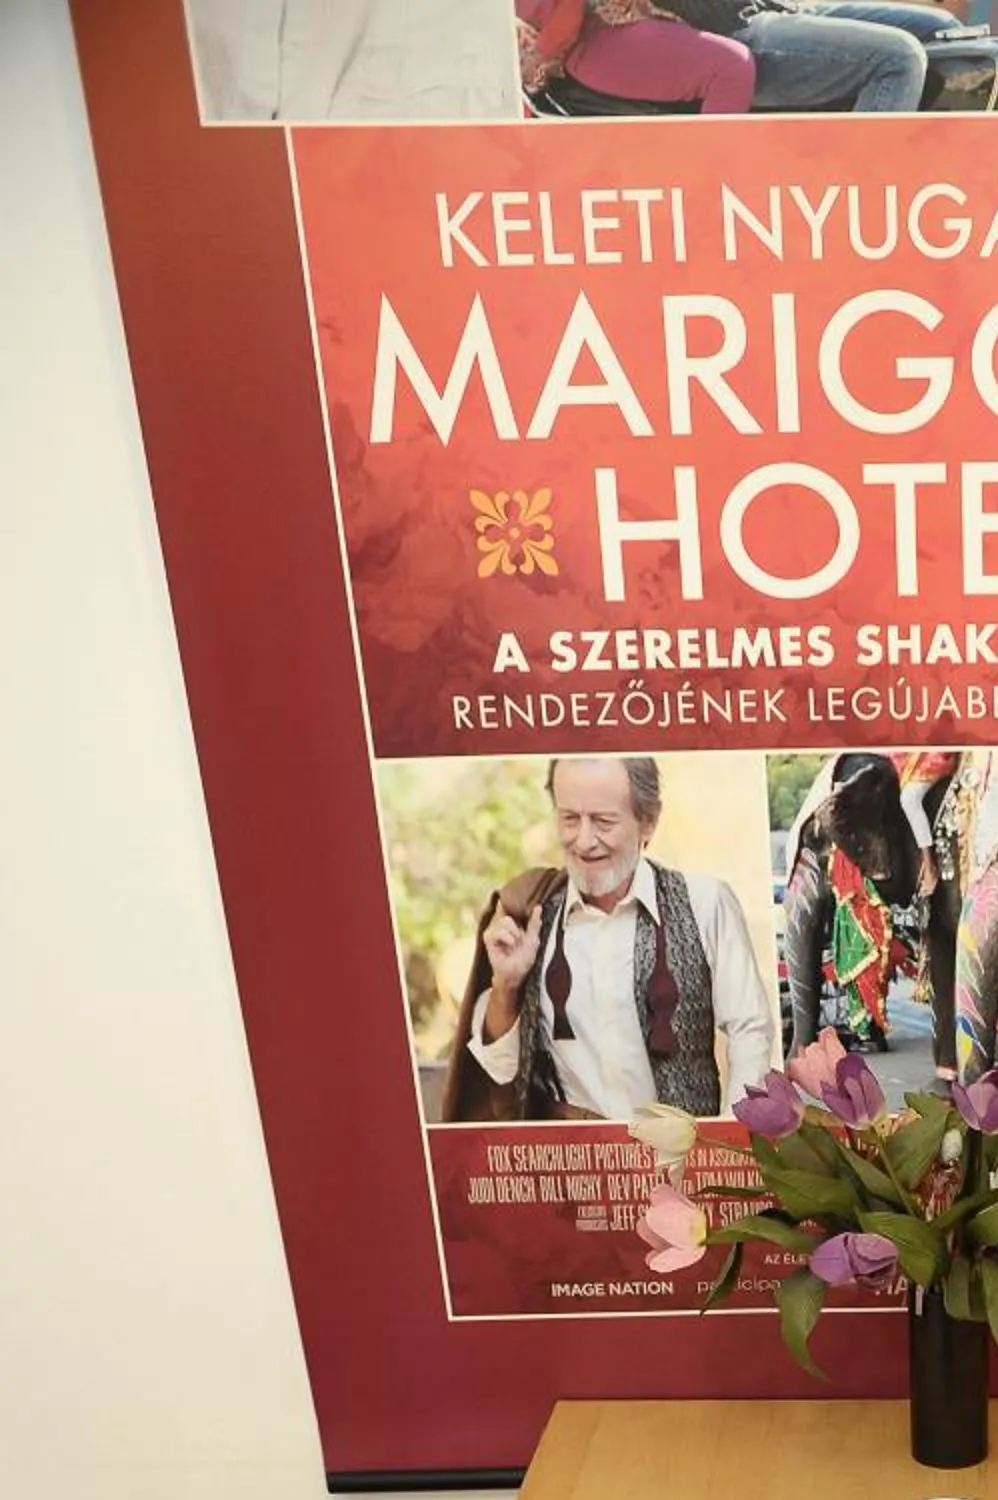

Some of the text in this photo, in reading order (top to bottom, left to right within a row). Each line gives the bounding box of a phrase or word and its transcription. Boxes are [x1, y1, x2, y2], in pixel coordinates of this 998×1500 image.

[435, 187, 688, 267] KELETI
[493, 633, 530, 674] A
[549, 625, 836, 672] SZERELMES
[453, 680, 787, 729] RENDEZŐJÉNEK
[487, 1145, 512, 1172] FOX
[514, 1144, 592, 1171] SEARCHLIGHT
[594, 1143, 651, 1170] PICTURES
[540, 1174, 566, 1202] BILL
[607, 1173, 632, 1201] DEV
[610, 1204, 636, 1232] JEFF
[763, 1254, 781, 1266] AZ
[551, 1280, 674, 1297] IMAGE NATION
